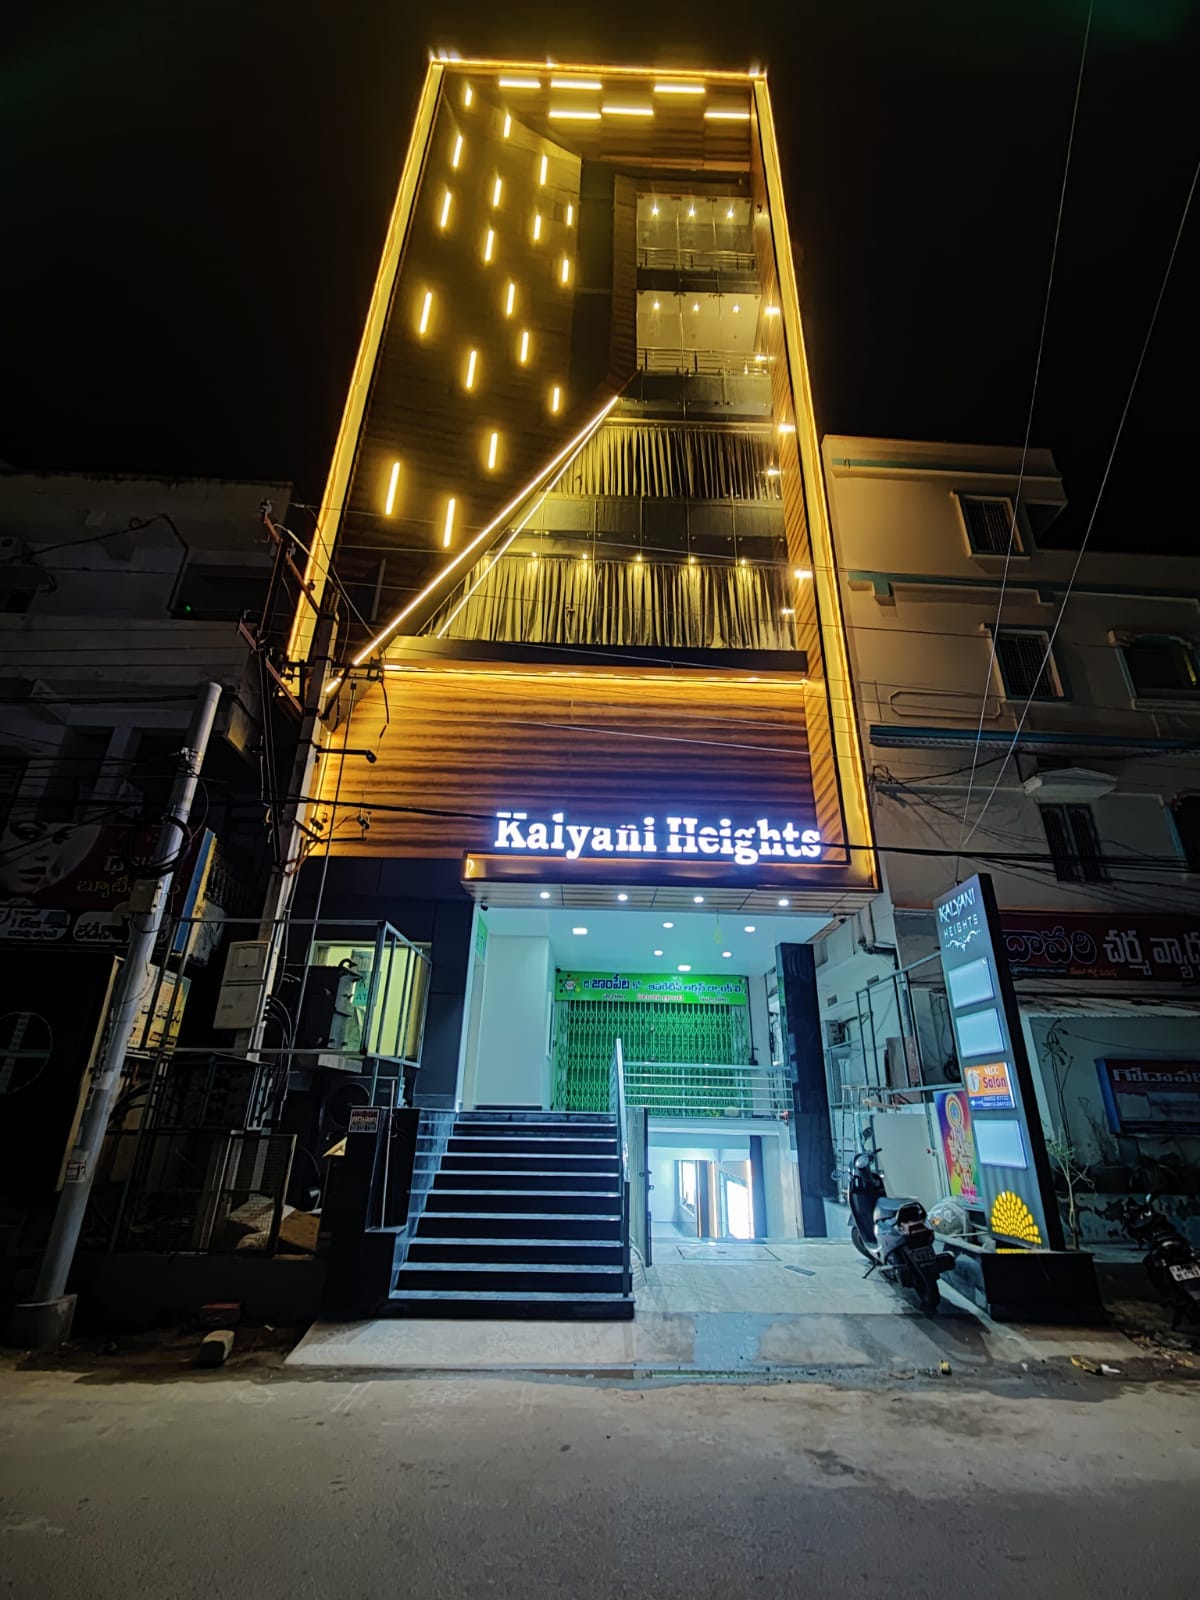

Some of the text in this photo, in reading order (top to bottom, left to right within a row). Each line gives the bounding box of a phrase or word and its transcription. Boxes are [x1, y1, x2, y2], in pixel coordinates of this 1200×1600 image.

[495, 811, 822, 866] Kalyani Heights
[938, 887, 976, 923] KALYANI
[943, 913, 979, 939] HEIGHTS
[982, 1076, 1007, 1089] Salon
